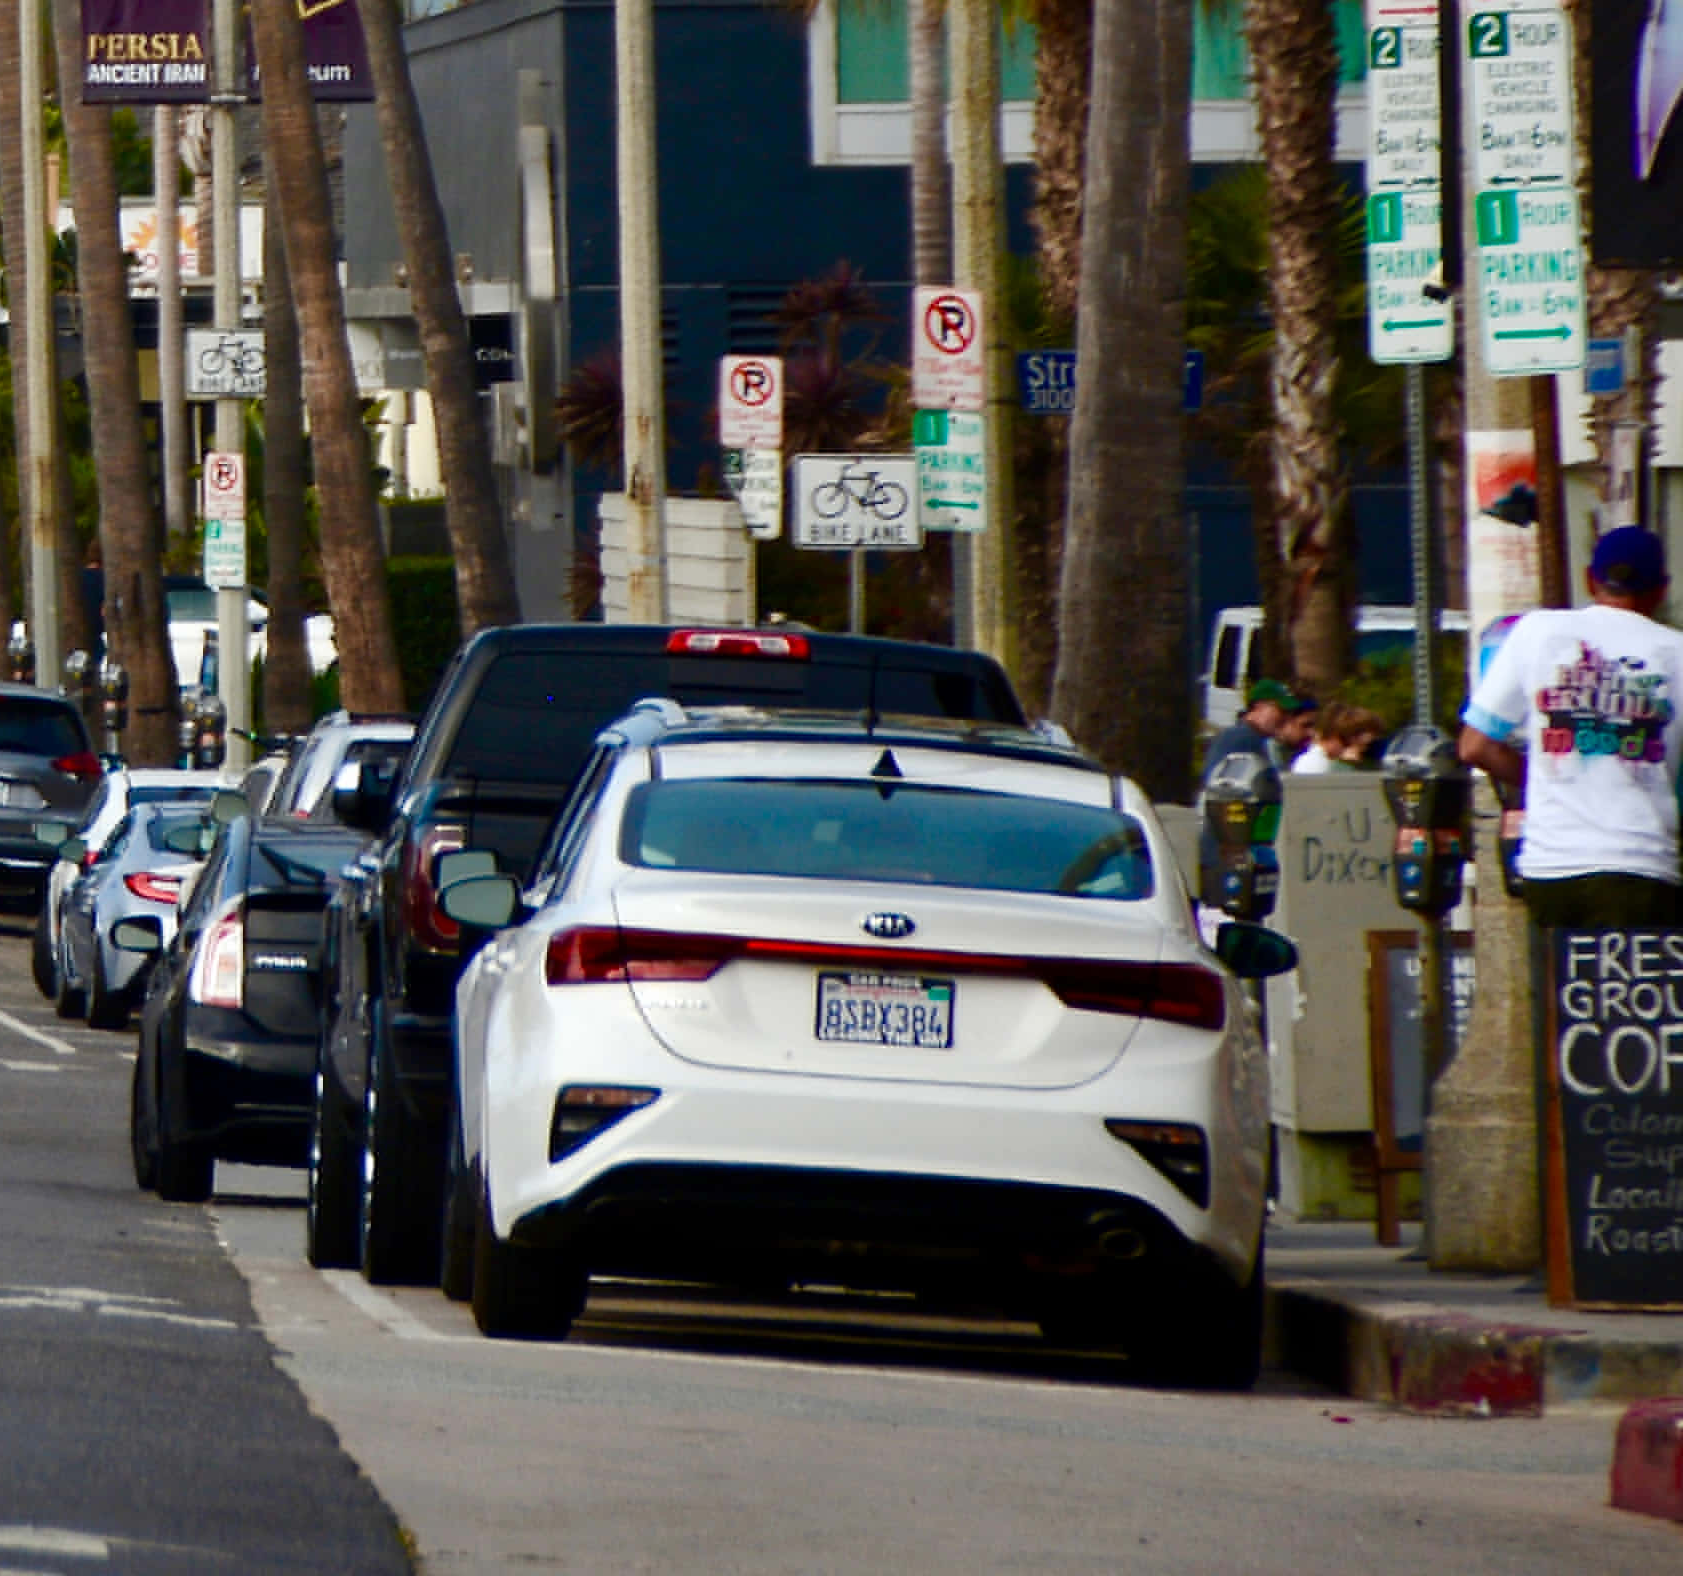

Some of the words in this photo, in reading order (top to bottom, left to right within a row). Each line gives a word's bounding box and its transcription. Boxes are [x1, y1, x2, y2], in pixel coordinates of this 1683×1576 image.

[88, 32, 204, 60] PERSIA
[1375, 31, 1396, 66] 2
[1477, 15, 1502, 52] 2
[1514, 23, 1559, 48] HOUR
[1486, 61, 1554, 79] ELECTRIC
[1492, 80, 1549, 97] VEHICLE
[1485, 98, 1559, 116] CHARGING
[1381, 201, 1391, 235] 1
[1492, 198, 1504, 233] 1
[1521, 200, 1572, 227] HOUR
[1483, 249, 1579, 285] PARKING
[808, 523, 853, 543] BIKE
[858, 523, 909, 544] LANE
[867, 914, 913, 936] KIA
[825, 998, 944, 1036] 8SBX384
